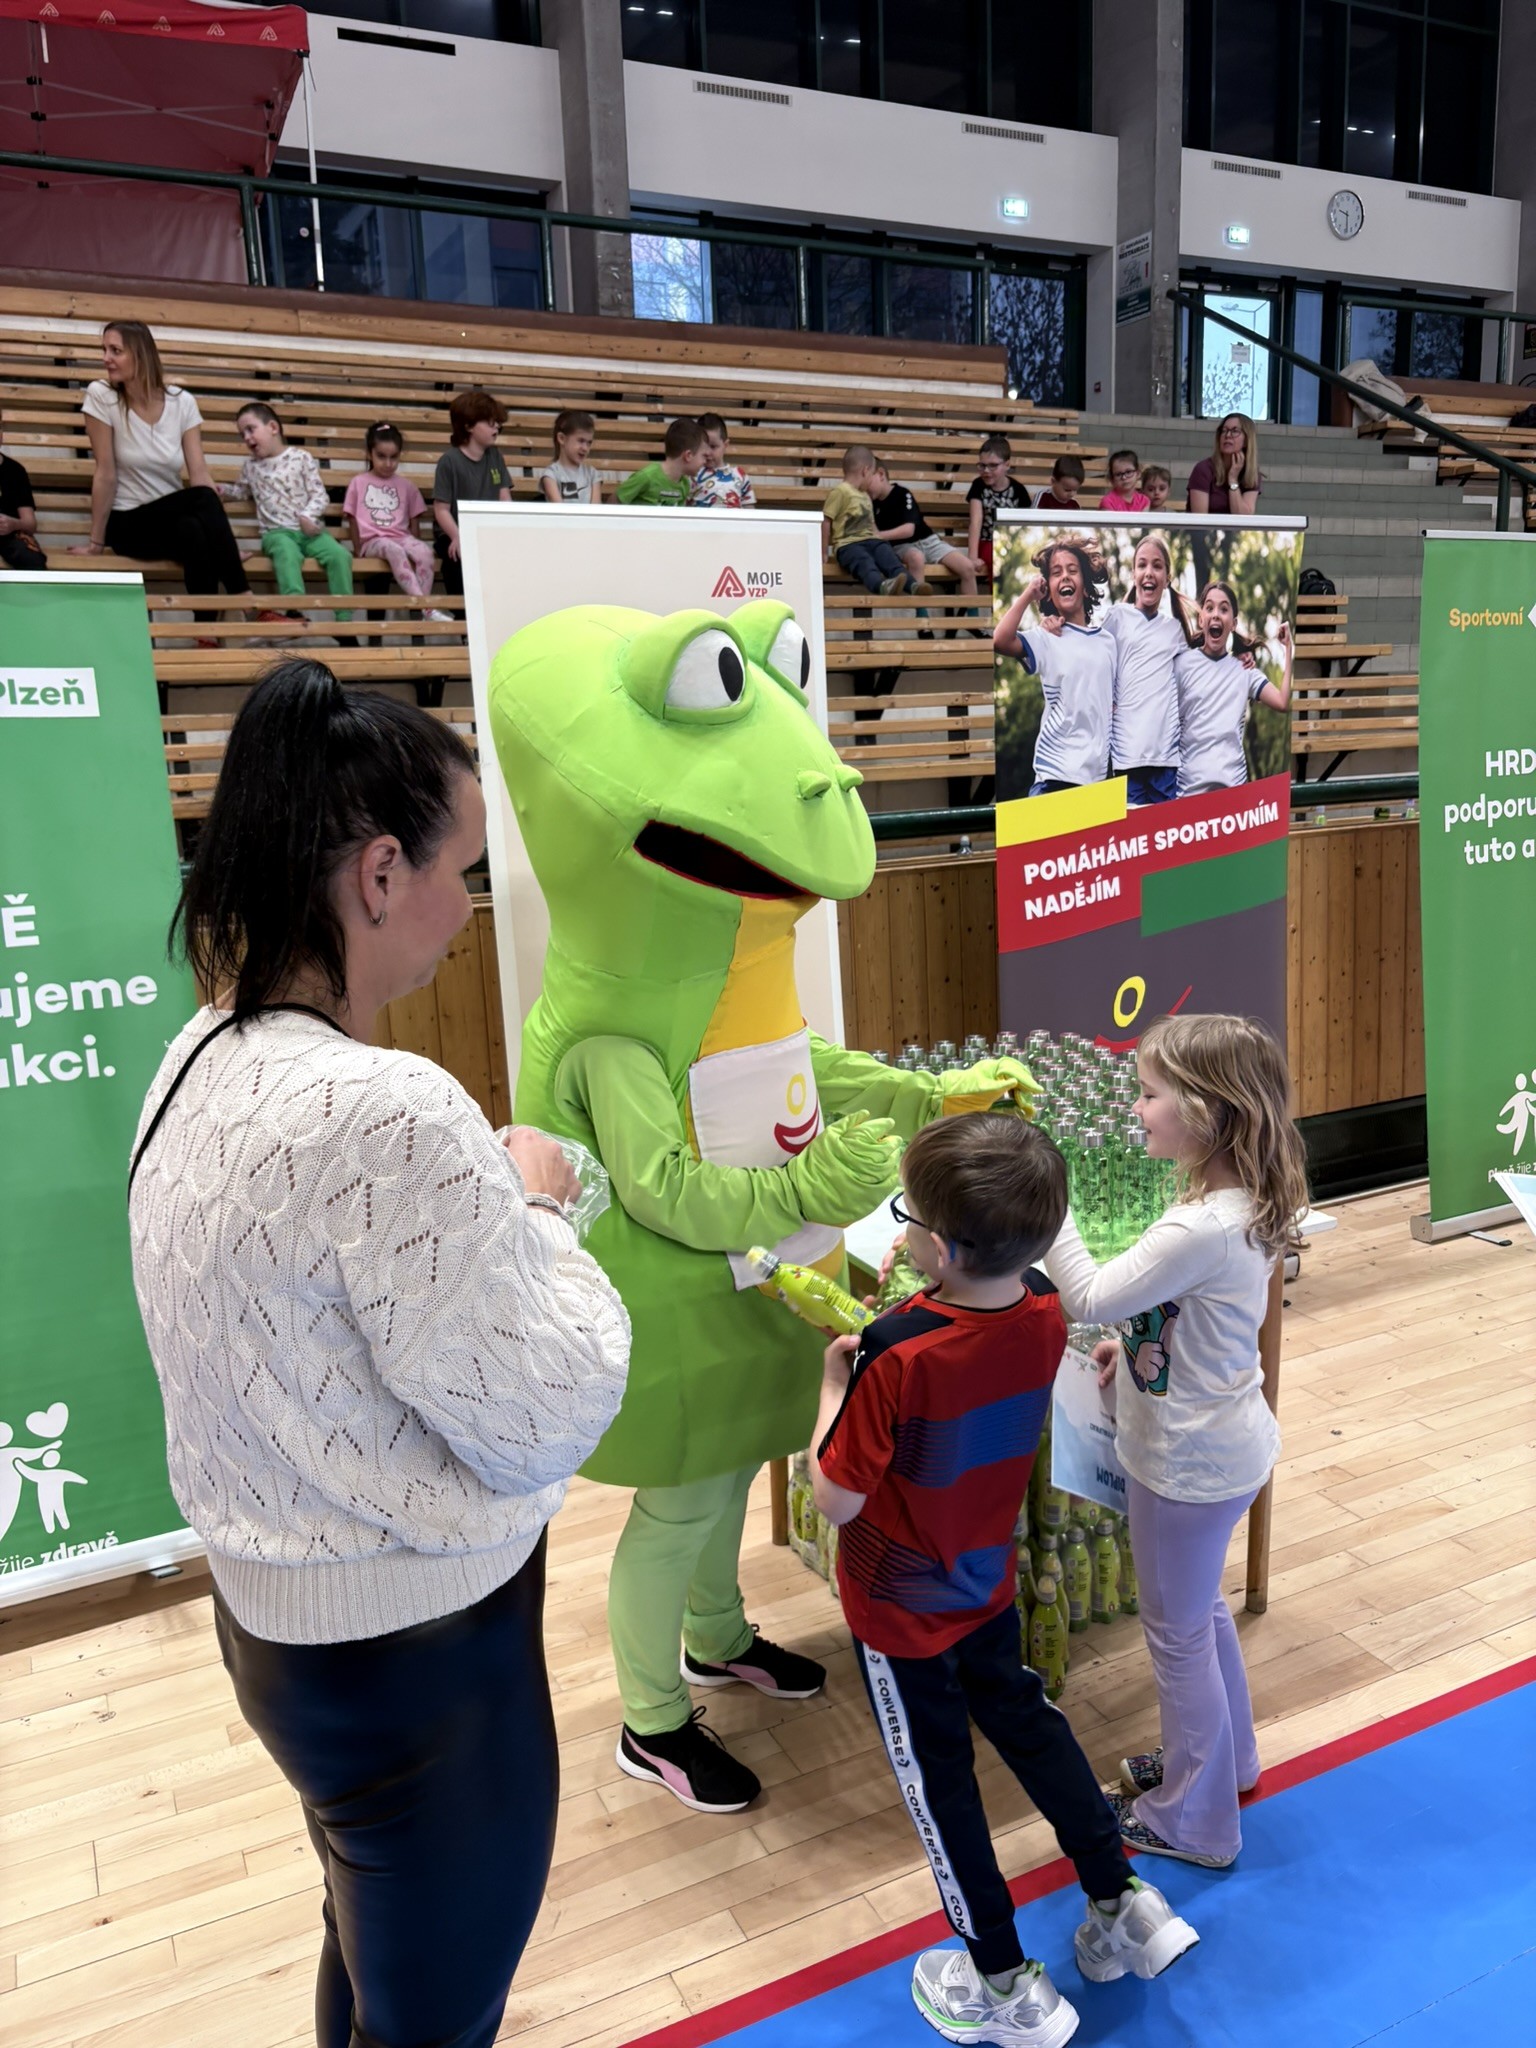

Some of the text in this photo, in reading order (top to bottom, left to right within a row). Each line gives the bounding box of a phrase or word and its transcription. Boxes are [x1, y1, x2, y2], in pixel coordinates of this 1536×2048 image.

[747, 572, 783, 587] MOJE
[748, 588, 768, 597] VZP
[1449, 606, 1523, 631] Sportovní
[1485, 748, 1536, 777] HRD
[1023, 799, 1279, 885] POMÁHÁME SPORTOVNÍM
[1464, 837, 1536, 864] tuto a
[1024, 874, 1120, 920] NADĚJÍM
[1096, 1466, 1126, 1494] DIPLOM
[40, 1530, 119, 1564] zdravě
[877, 1677, 904, 1757] CONVERSE
[906, 1784, 943, 1872] CONVERSE
[951, 1895, 968, 1934] CON
